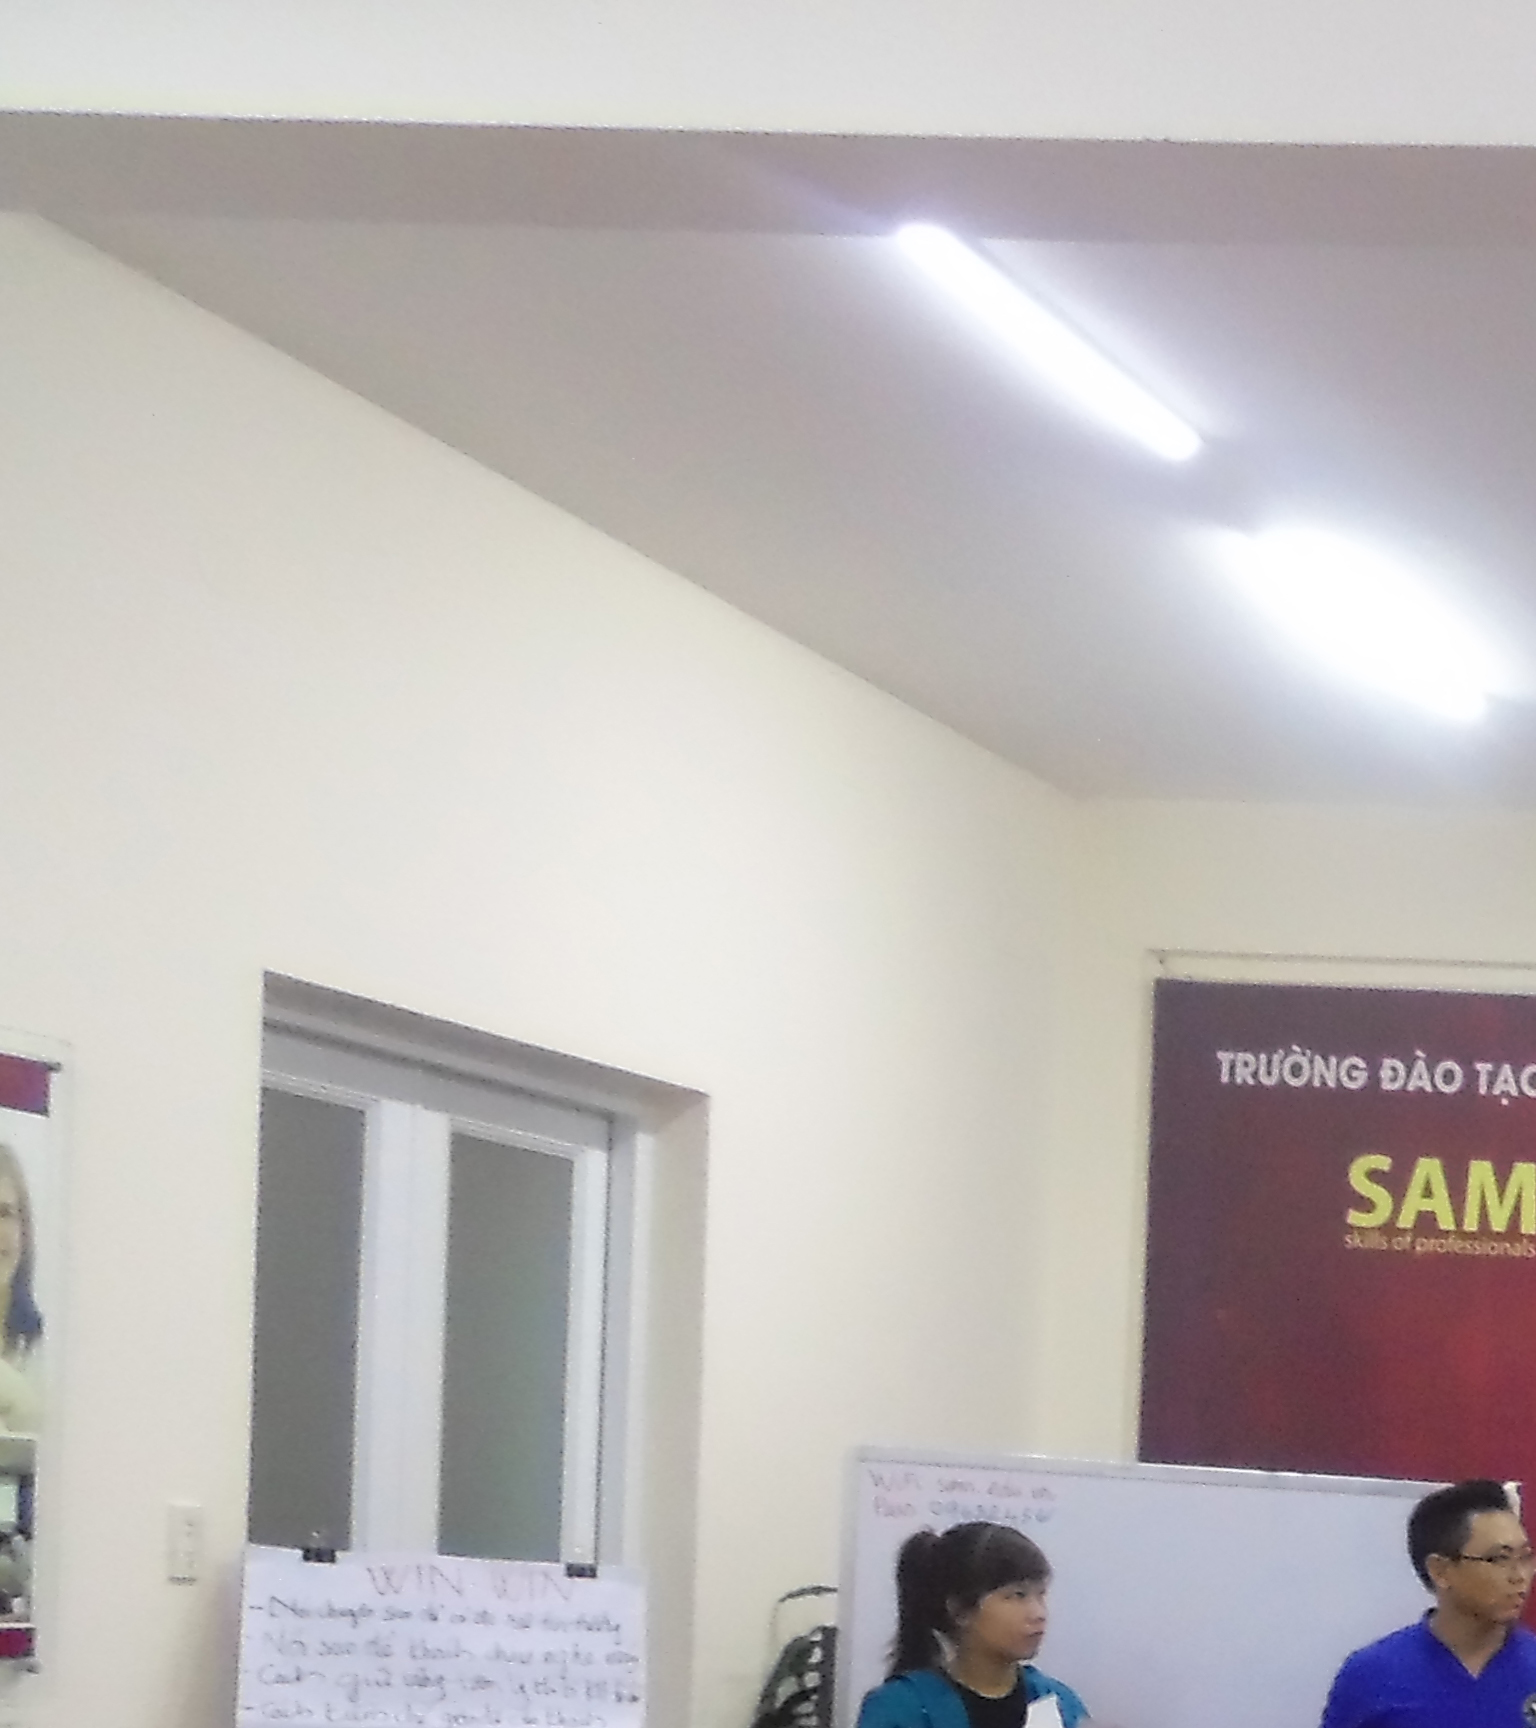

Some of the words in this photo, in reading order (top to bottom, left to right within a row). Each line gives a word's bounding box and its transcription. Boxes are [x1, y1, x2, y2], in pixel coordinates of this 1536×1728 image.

[1216, 1045, 1369, 1090] TRƯỜNG
[1379, 1050, 1464, 1094] ĐÀO
[366, 1563, 465, 1597] WIN
